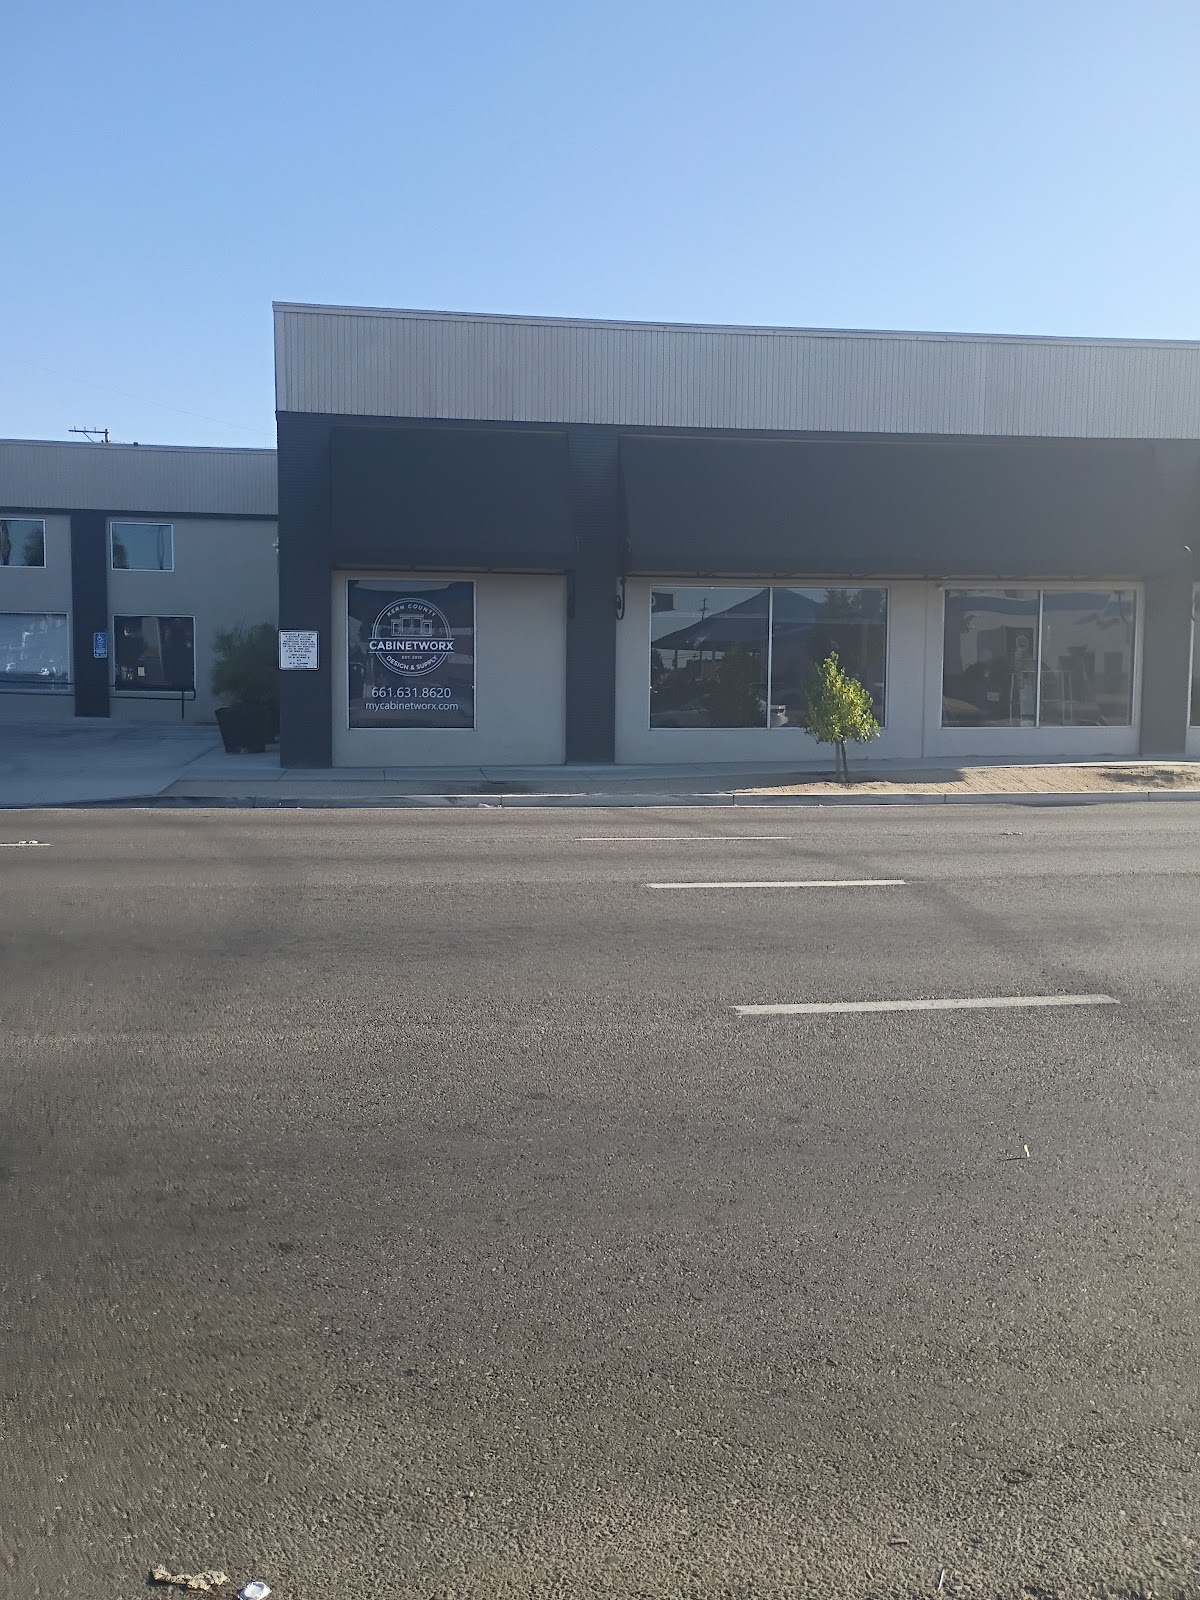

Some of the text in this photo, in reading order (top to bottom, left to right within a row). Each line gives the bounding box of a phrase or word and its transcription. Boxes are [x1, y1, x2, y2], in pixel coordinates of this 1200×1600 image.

[387, 603, 436, 617] KERN COUNTY
[369, 641, 454, 651] CABINETWORX
[386, 655, 409, 670] DESIGN
[416, 655, 438, 670] SUPPLY
[371, 687, 451, 698] 661.631.8620
[365, 701, 459, 712] mycabinetworx.com
